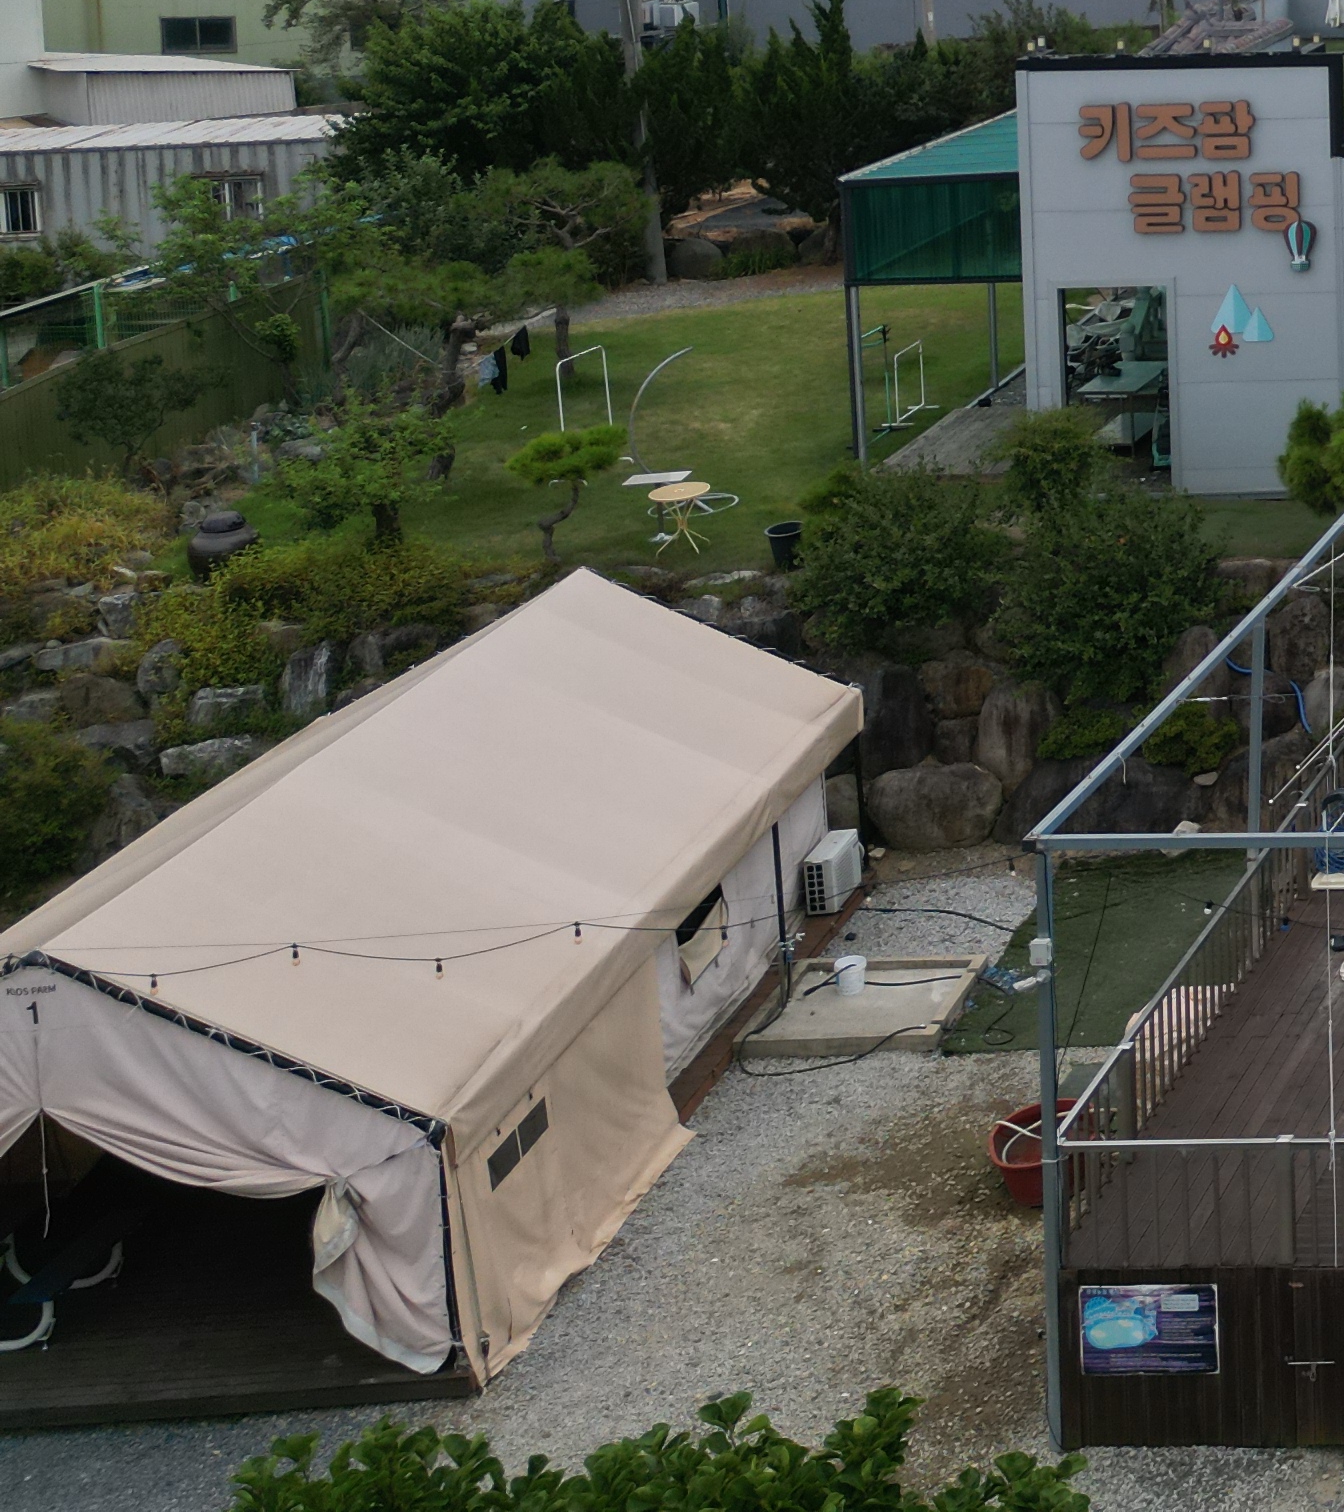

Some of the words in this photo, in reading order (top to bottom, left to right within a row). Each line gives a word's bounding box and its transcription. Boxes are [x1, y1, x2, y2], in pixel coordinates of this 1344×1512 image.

[1078, 99, 1256, 162] 키즈팜
[1128, 170, 1302, 234] 글램핑
[26, 1001, 39, 1025] 1
